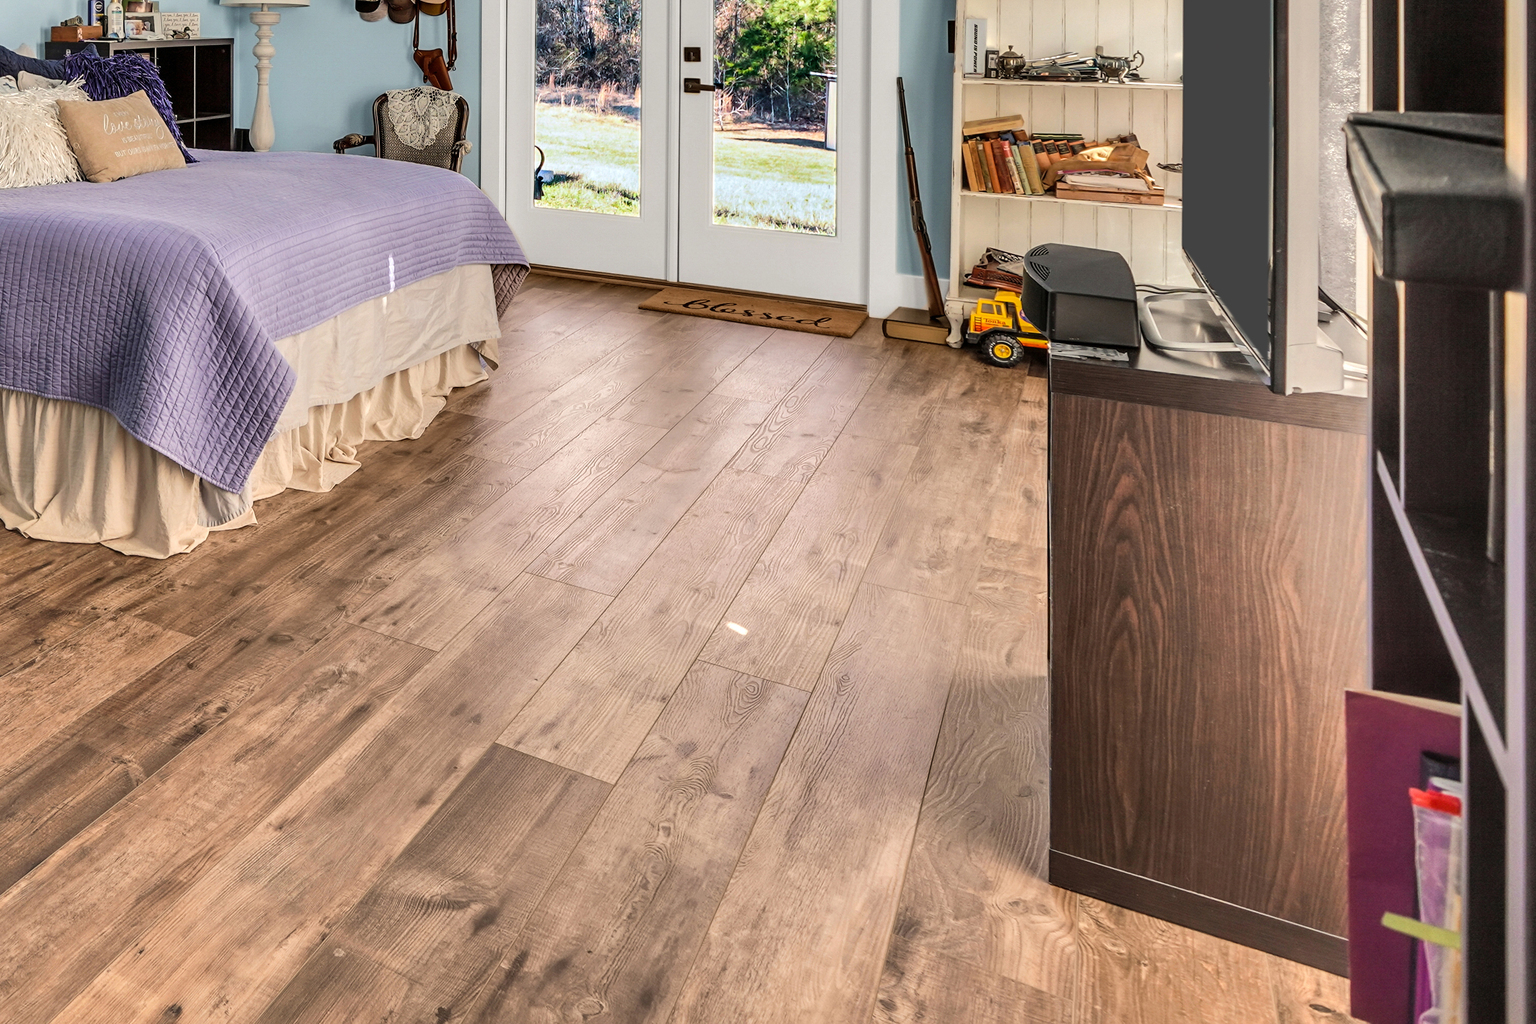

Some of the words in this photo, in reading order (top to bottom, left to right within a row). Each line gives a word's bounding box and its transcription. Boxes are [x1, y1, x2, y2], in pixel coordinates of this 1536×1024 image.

[103, 113, 133, 136] love
[663, 298, 833, 329] Blessed
[983, 317, 1007, 325] Tonka
